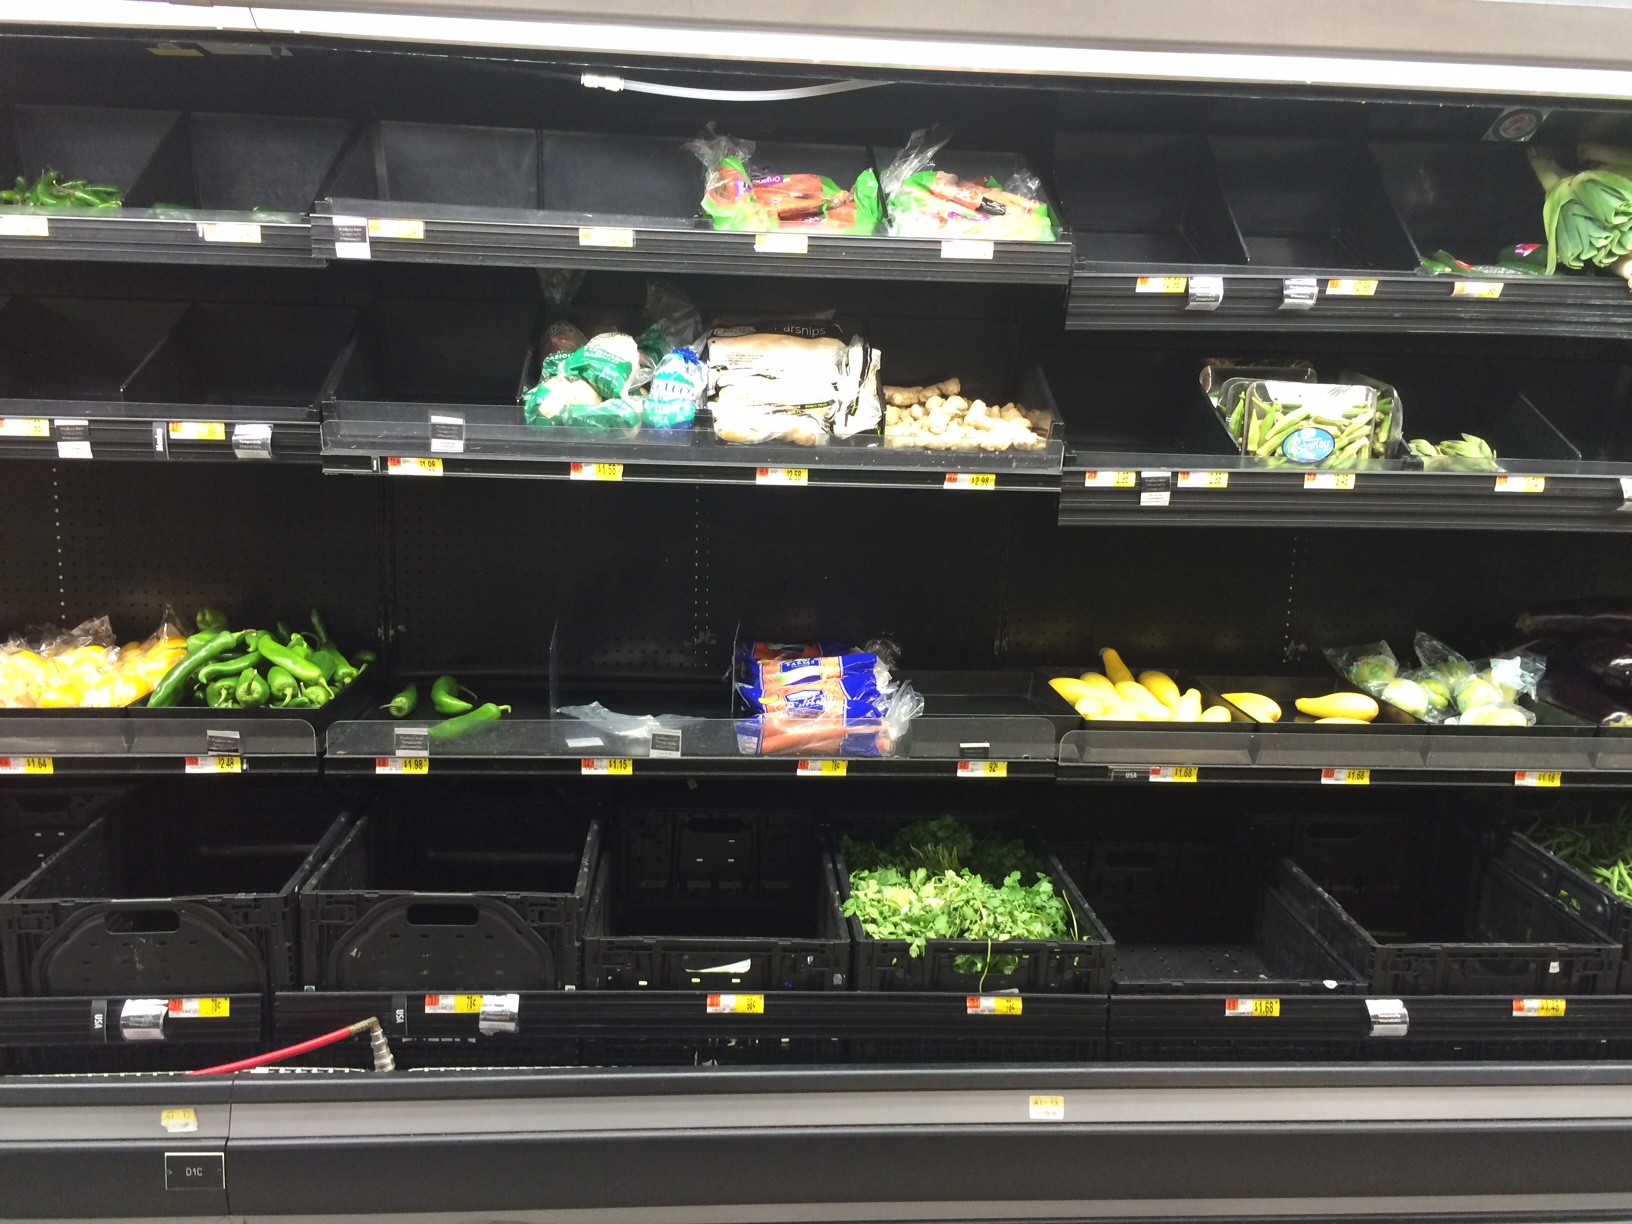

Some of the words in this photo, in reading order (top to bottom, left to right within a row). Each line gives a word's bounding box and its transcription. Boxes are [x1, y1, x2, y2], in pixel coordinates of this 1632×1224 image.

[971, 476, 990, 486] $2.98
[26, 758, 47, 769] $1.64
[218, 757, 235, 769] $2.48
[404, 759, 423, 770] $1.98
[608, 759, 628, 770] $1.15
[1175, 767, 1192, 778] $1.68
[1347, 770, 1365, 781] $1.68
[1254, 1001, 1274, 1014] $1.68
[94, 1014, 103, 1029] USA
[395, 1009, 404, 1023] USA
